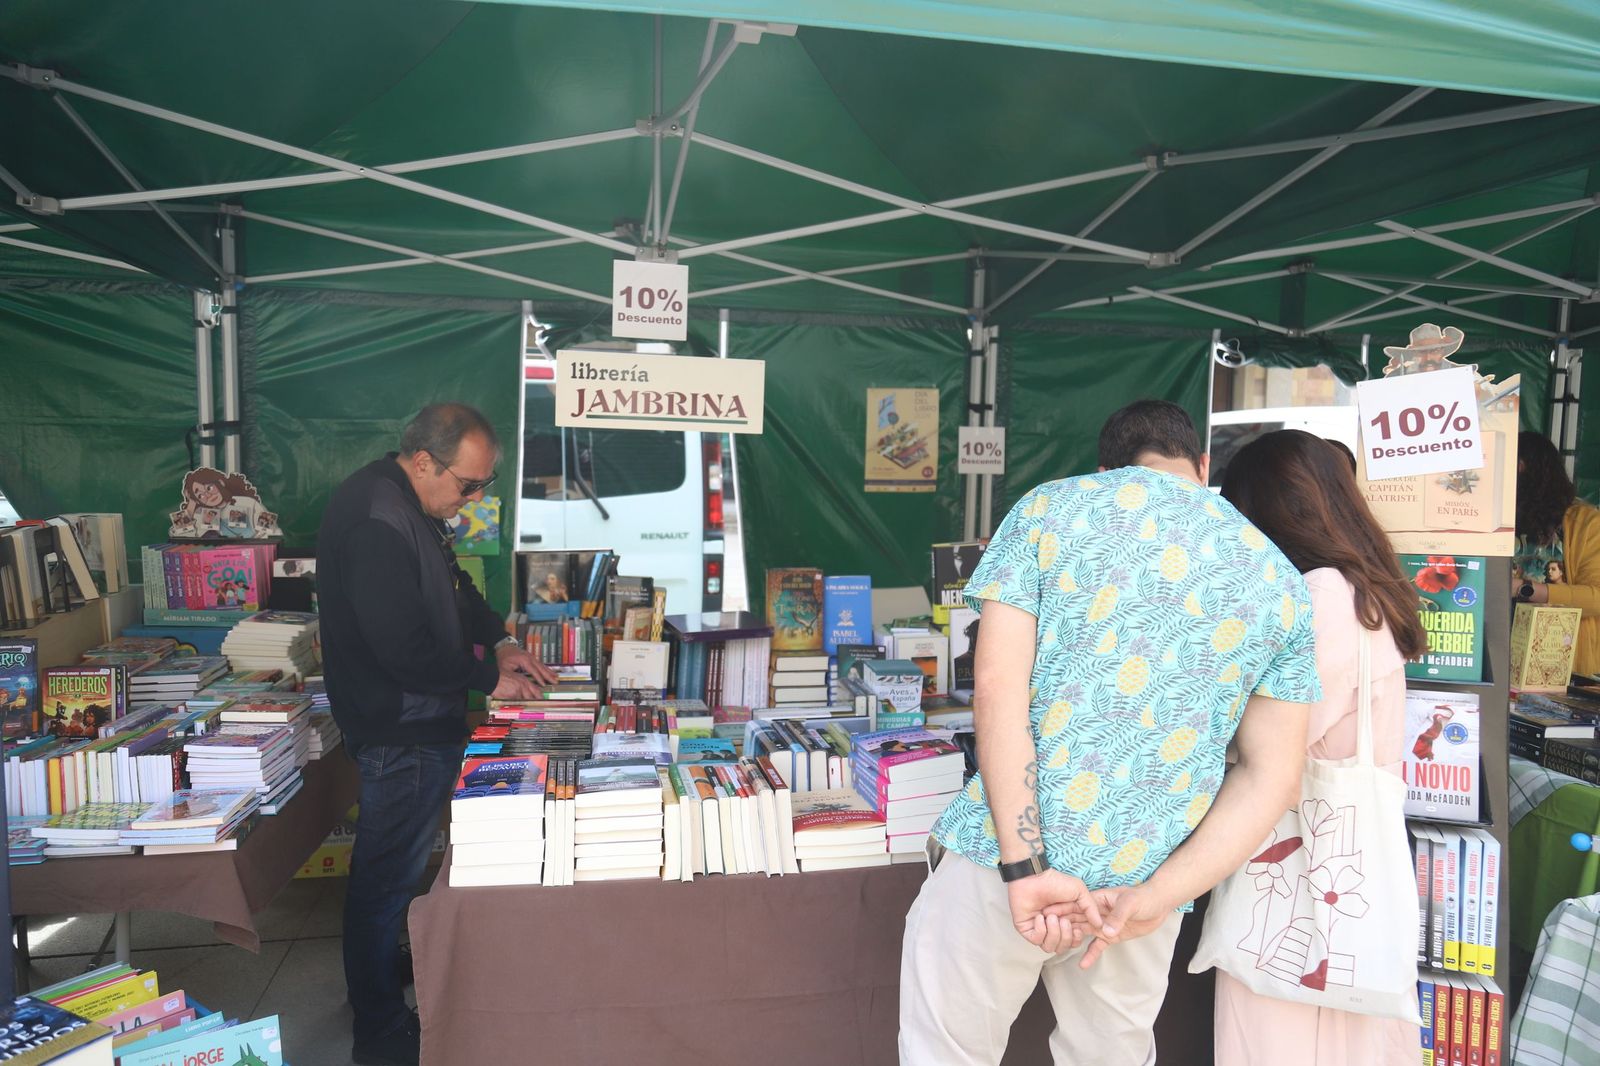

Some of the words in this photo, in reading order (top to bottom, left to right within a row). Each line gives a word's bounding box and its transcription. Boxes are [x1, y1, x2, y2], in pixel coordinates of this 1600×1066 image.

[619, 286, 683, 312] 10%
[617, 312, 682, 325] Descuento
[571, 362, 649, 382] librería
[571, 388, 748, 418] JAMBRINA
[1371, 401, 1471, 440] 10%
[962, 442, 1002, 457] 10%
[1372, 438, 1473, 460] Descuento
[1369, 484, 1414, 492] CAPITÁN
[1364, 494, 1418, 502] ALATRISTE
[1438, 506, 1450, 515] EN
[1452, 507, 1479, 517] PARÍS
[640, 532, 689, 540] RENAULT
[942, 590, 964, 606] MEN
[1426, 632, 1474, 654] DEBBIE
[1428, 655, 1473, 667] McFADDEN
[48, 676, 108, 696] HEREDEROS
[890, 688, 909, 696] Aves
[1415, 762, 1470, 792] NOVIO
[1408, 790, 1421, 800] IDA
[1426, 792, 1470, 806] McFADDEN
